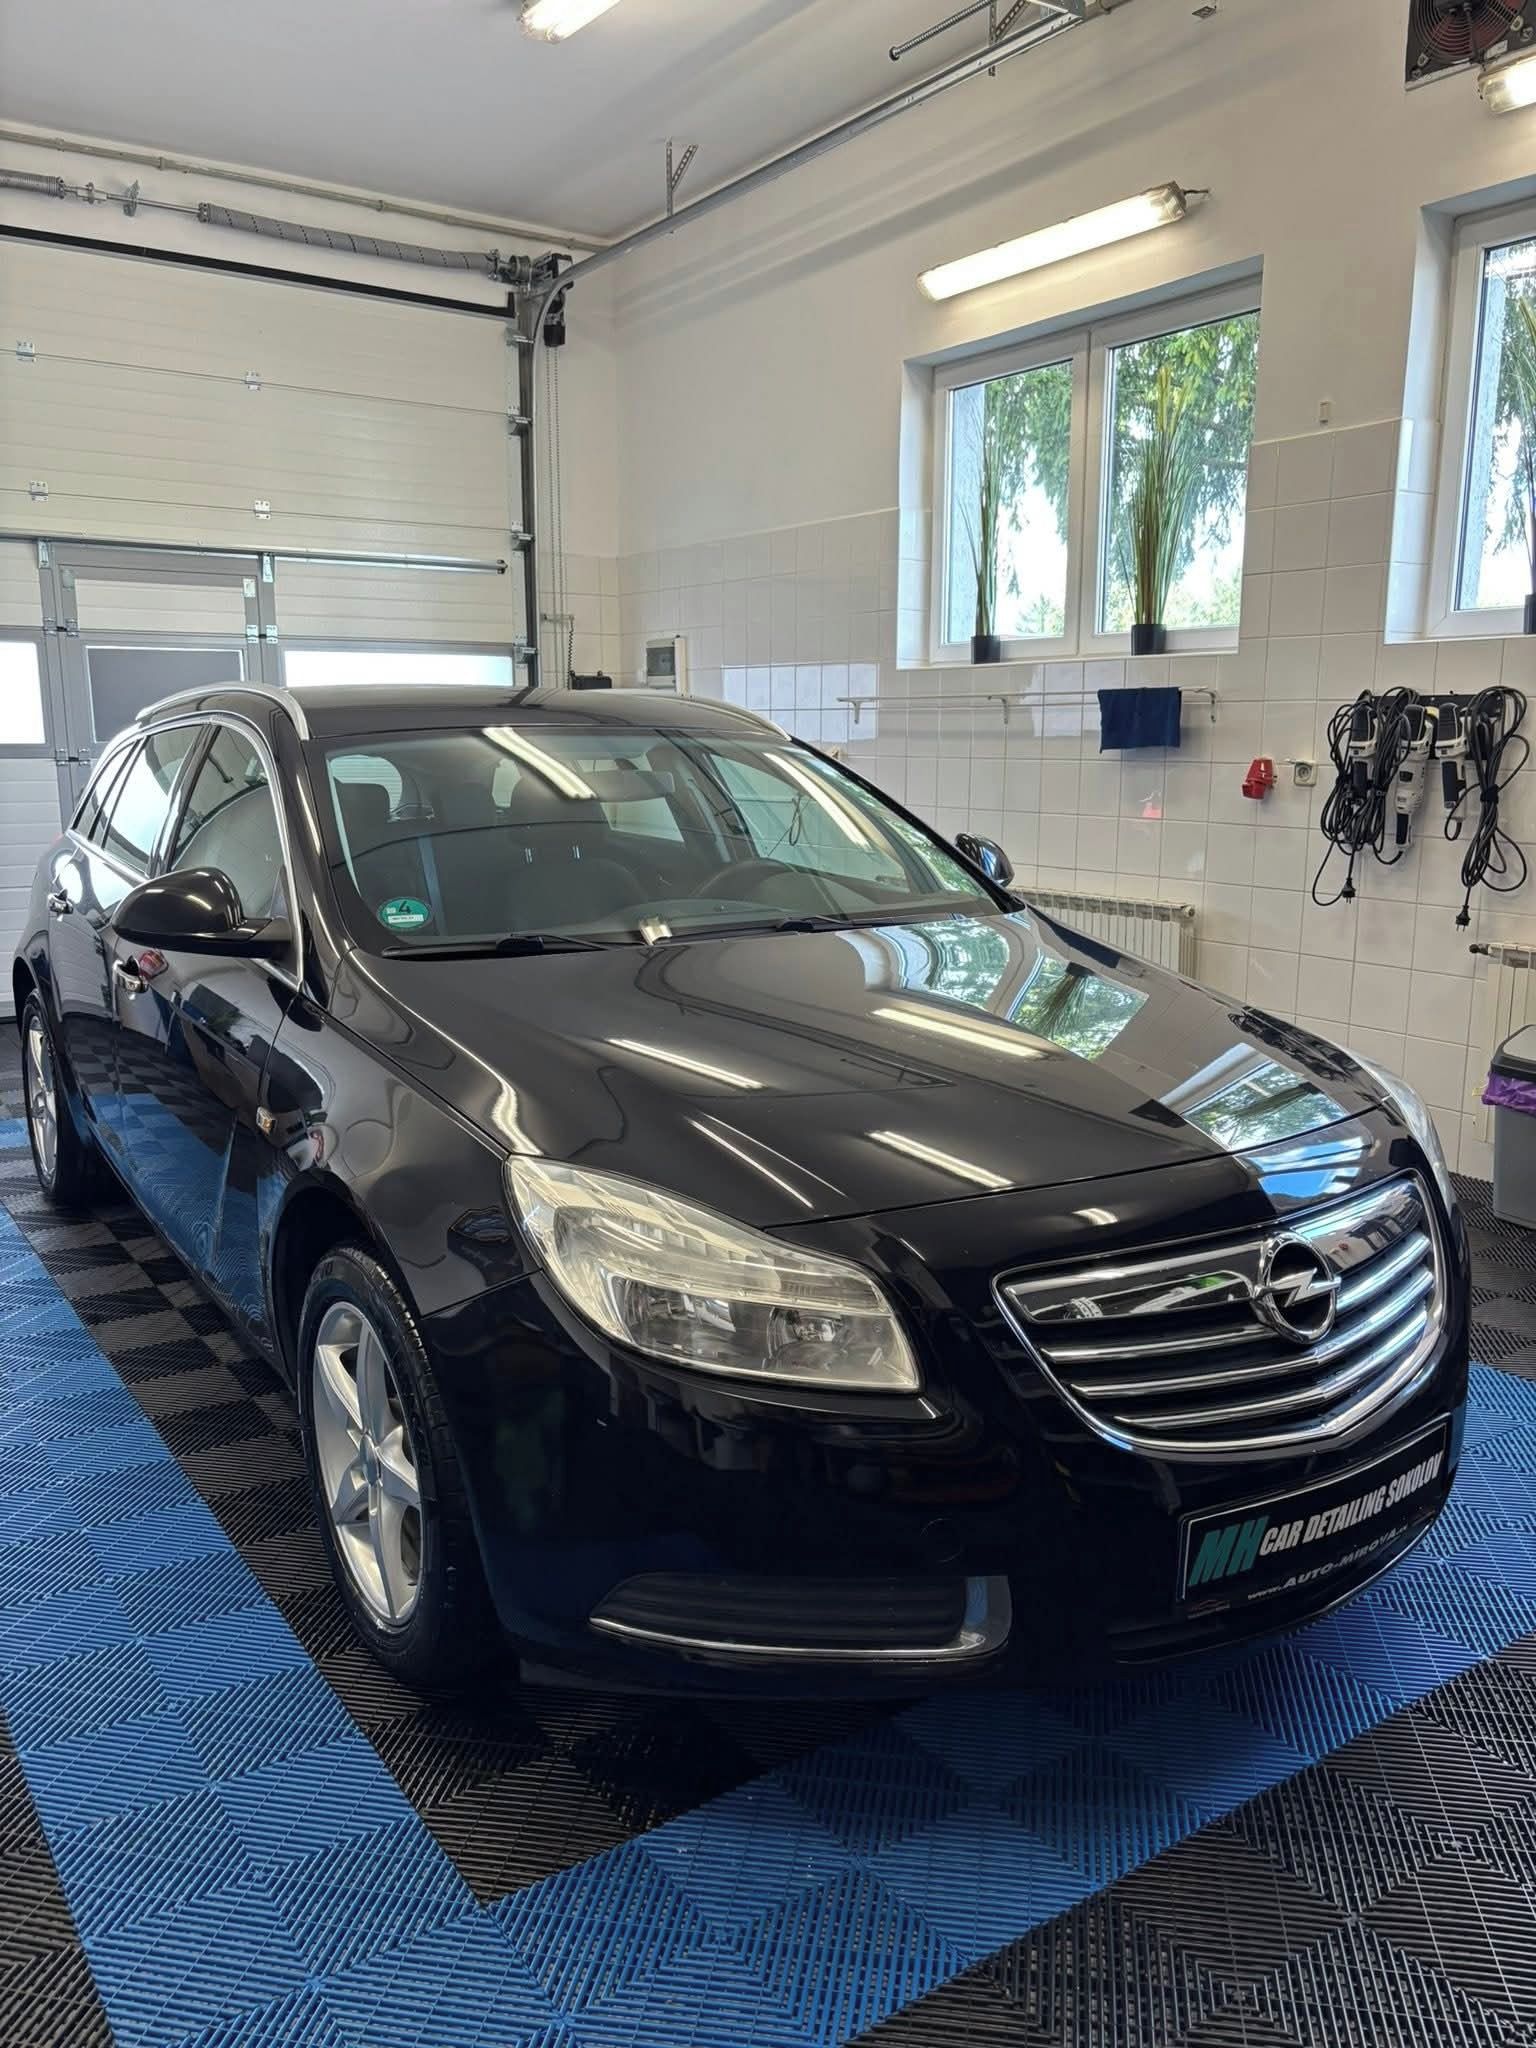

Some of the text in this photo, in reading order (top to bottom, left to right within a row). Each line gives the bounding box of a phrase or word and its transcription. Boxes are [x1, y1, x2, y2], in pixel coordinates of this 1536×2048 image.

[398, 900, 412, 914] 4
[1188, 1450, 1445, 1586] MH CAR DETAILING SOKOLOV
